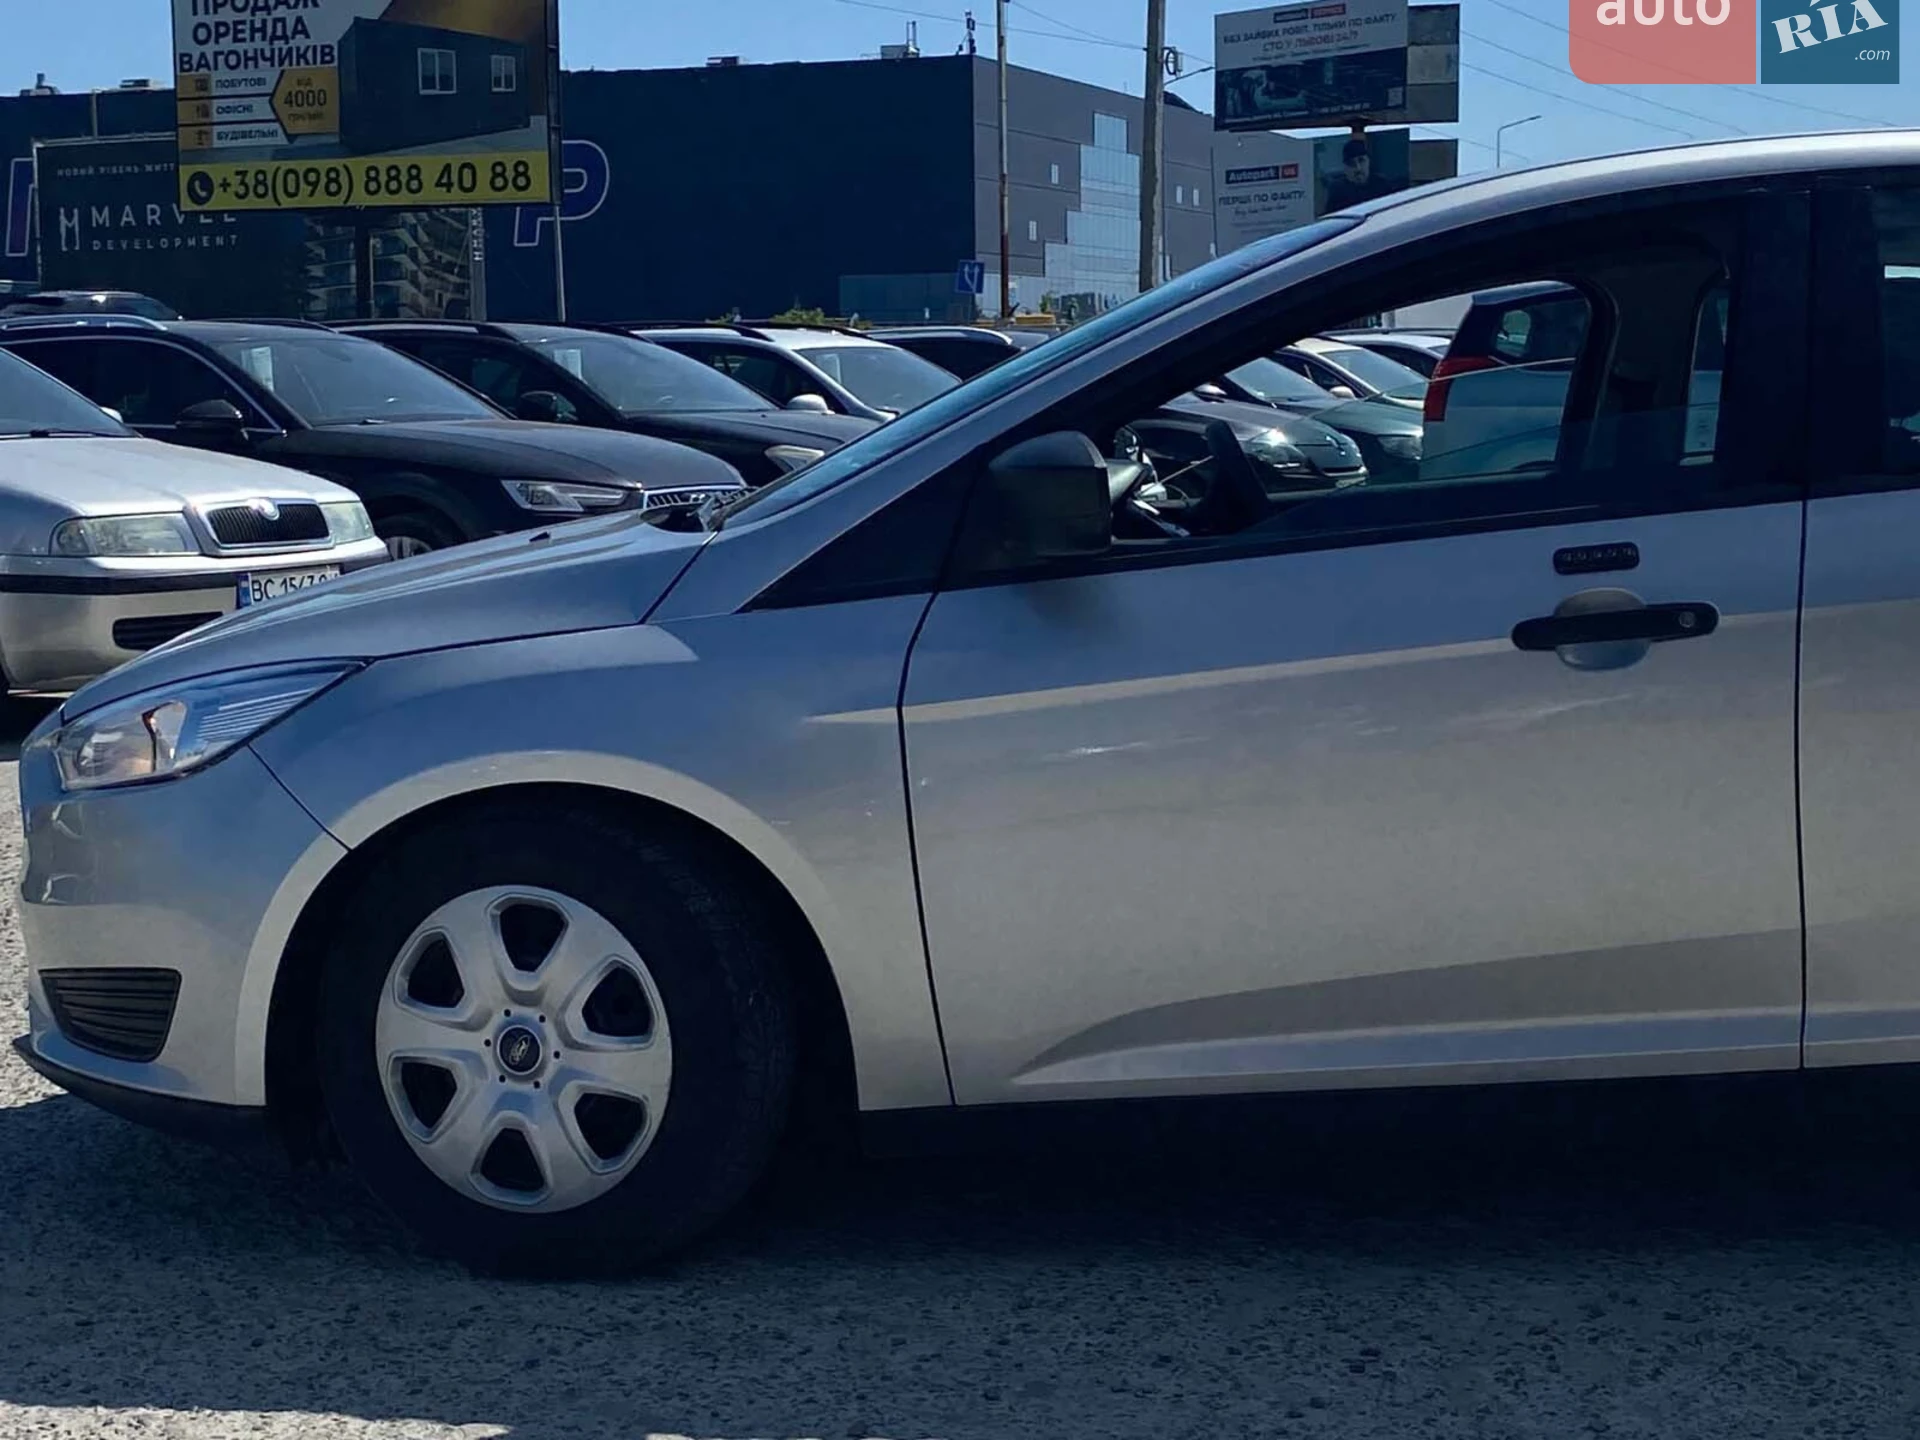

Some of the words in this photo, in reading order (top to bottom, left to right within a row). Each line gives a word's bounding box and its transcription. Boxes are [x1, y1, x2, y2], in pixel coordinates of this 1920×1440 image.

[192, 15, 311, 46] ОРЕНДА
[178, 44, 335, 73] ВАГОНЧИКІВ
[215, 77, 267, 89] ПОБУТОВІ
[284, 89, 327, 108] 4000
[218, 164, 354, 206] +38(098)
[363, 163, 424, 196] 888
[434, 161, 478, 194] 40
[489, 159, 532, 193] 88
[92, 234, 238, 251] DEVELOPMENT
